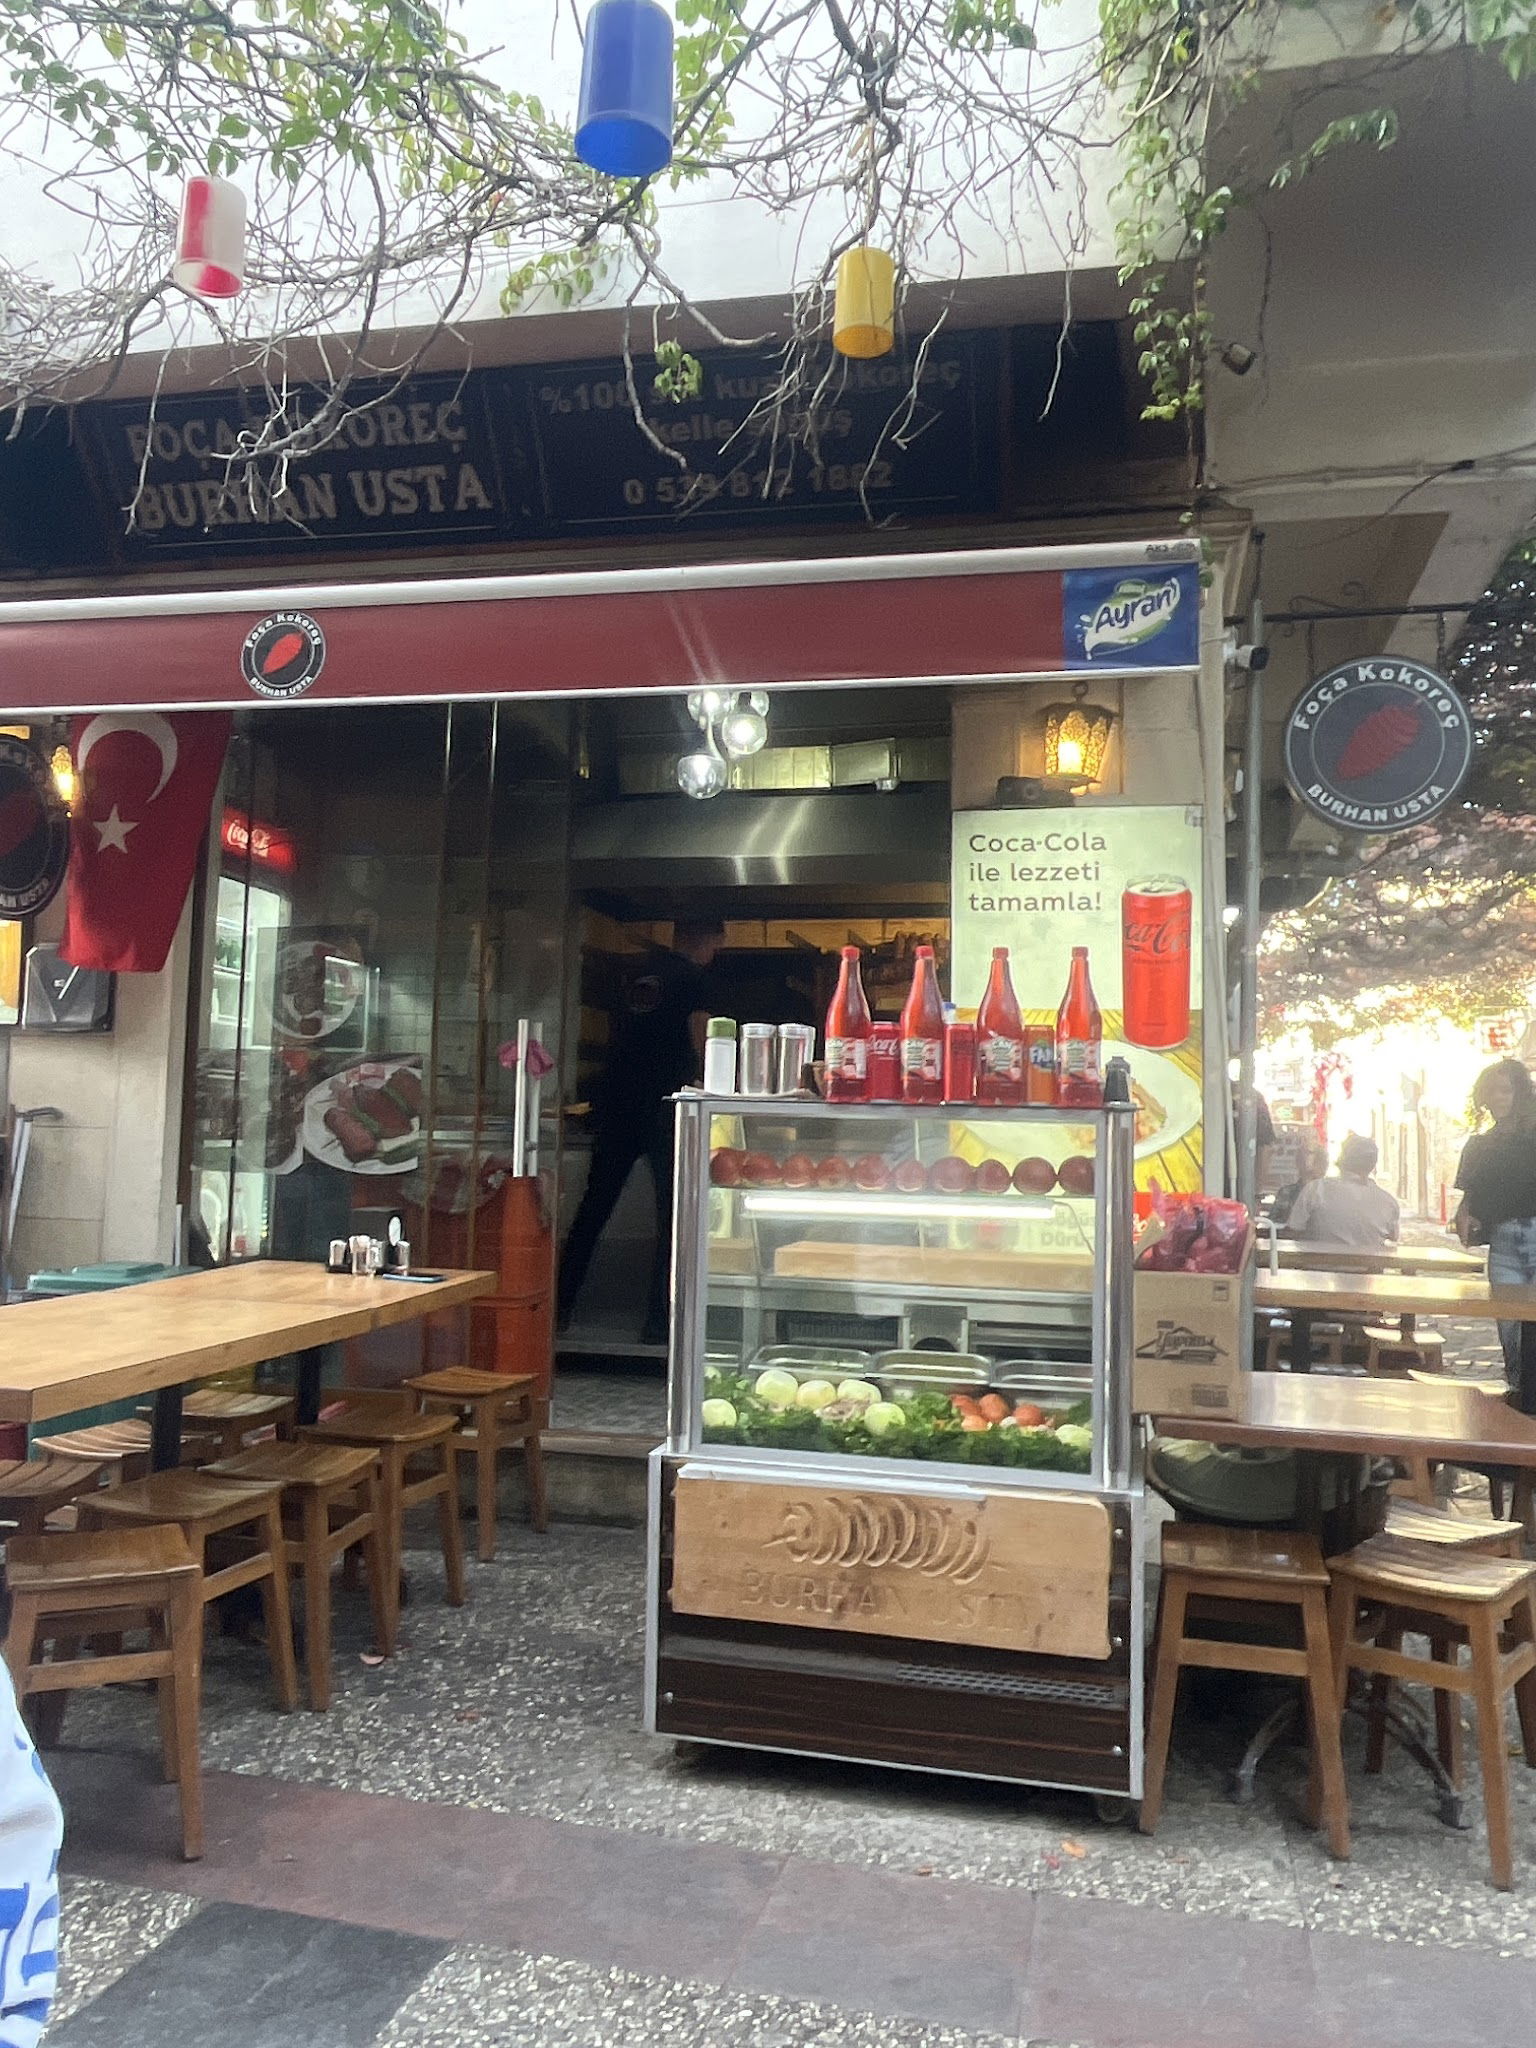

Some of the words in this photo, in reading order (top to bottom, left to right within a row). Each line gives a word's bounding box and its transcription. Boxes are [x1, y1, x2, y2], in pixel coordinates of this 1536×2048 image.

[134, 472, 338, 531] BURHAN
[347, 462, 494, 517] USTA
[622, 478, 645, 505] 0
[1096, 588, 1171, 634] Ayran
[245, 619, 274, 648] Foça
[250, 676, 288, 697] BURHAN
[1294, 677, 1349, 730] Foça
[1357, 664, 1460, 730] Kokoreç
[1307, 783, 1388, 822] BURHAN
[1393, 784, 1446, 820] USTA
[969, 862, 1000, 882] ile
[1010, 861, 1100, 882] lezzeti
[969, 891, 1101, 912] tamamla!
